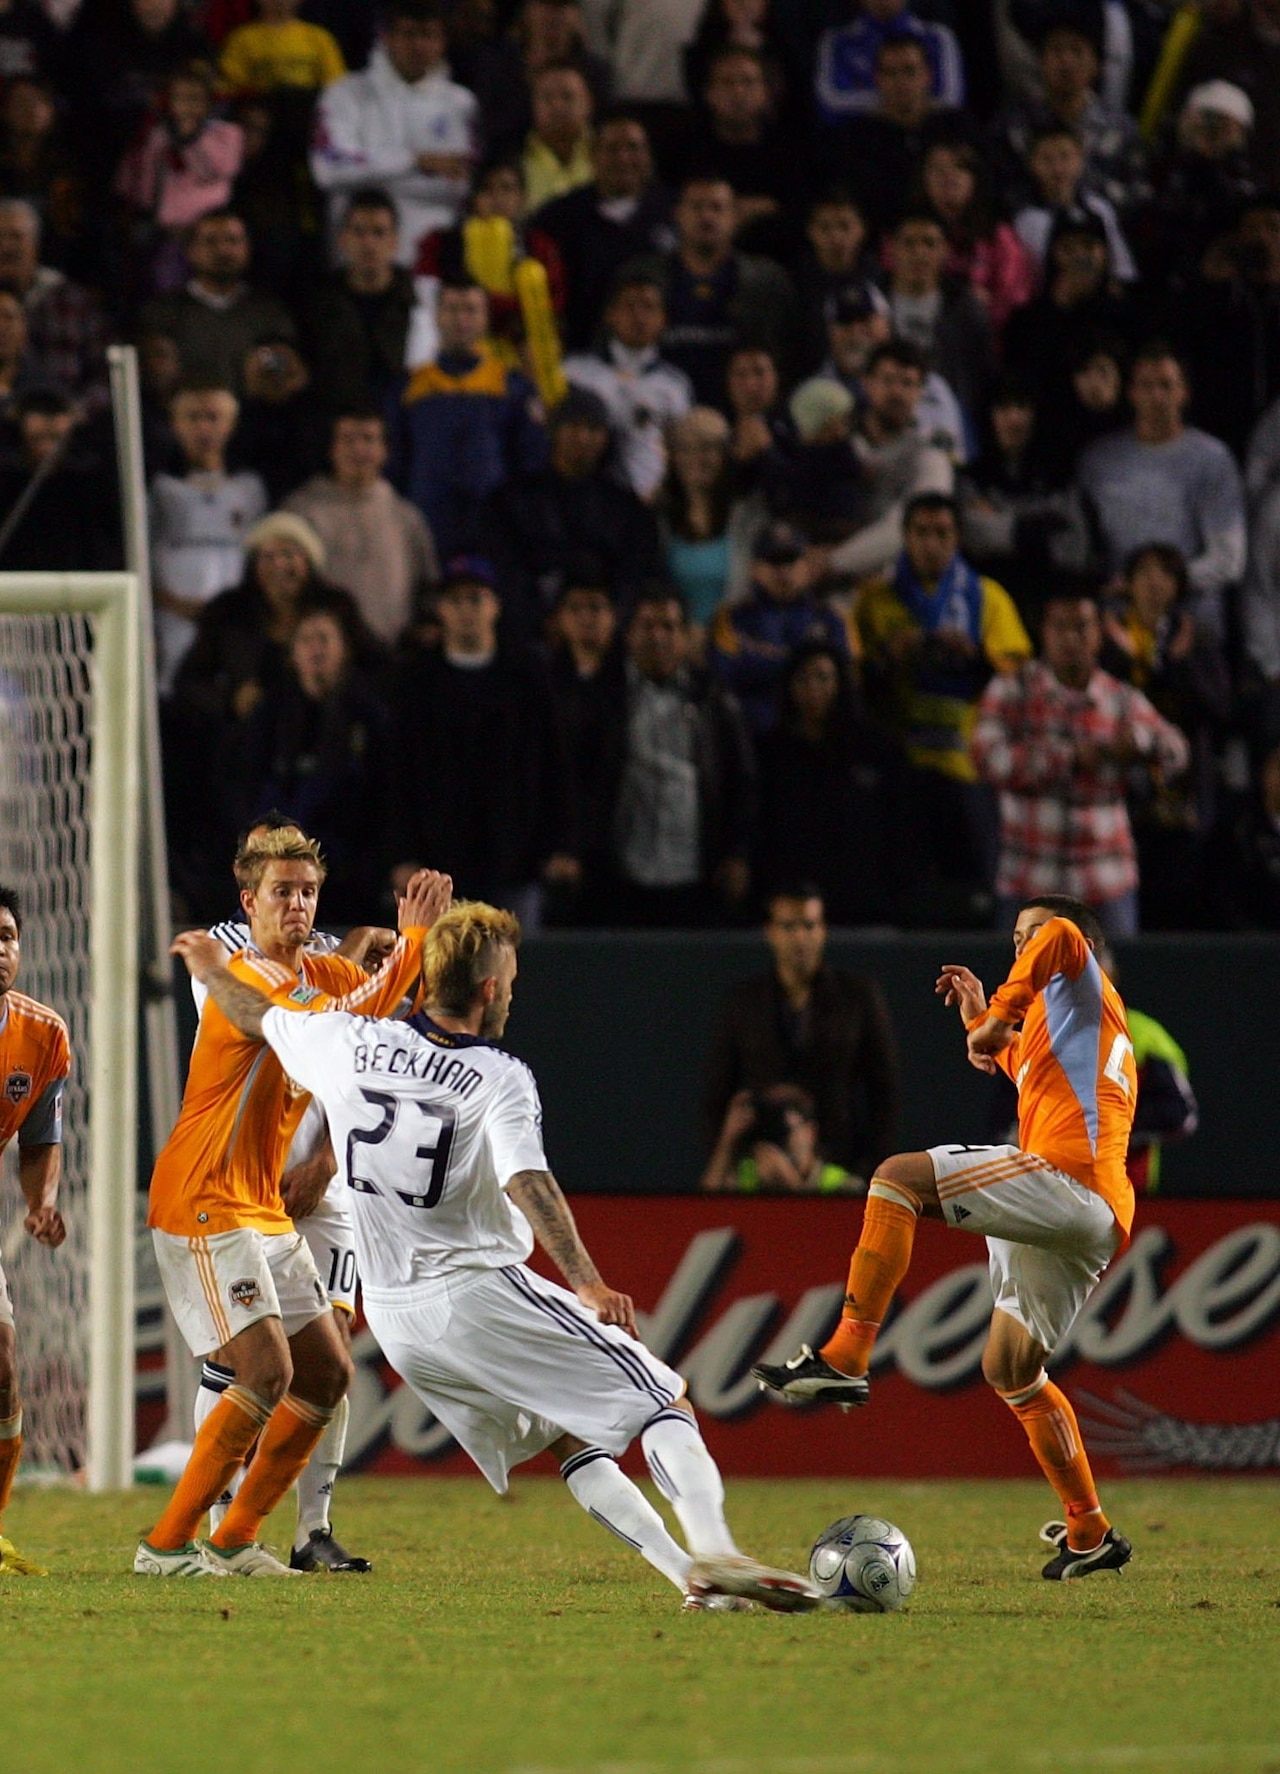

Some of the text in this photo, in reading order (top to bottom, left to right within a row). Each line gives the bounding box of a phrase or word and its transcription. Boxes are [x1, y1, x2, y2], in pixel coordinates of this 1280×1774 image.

[354, 1043, 483, 1100] BECKHAM
[346, 1088, 460, 1209] 23
[327, 1247, 355, 1293] 10
